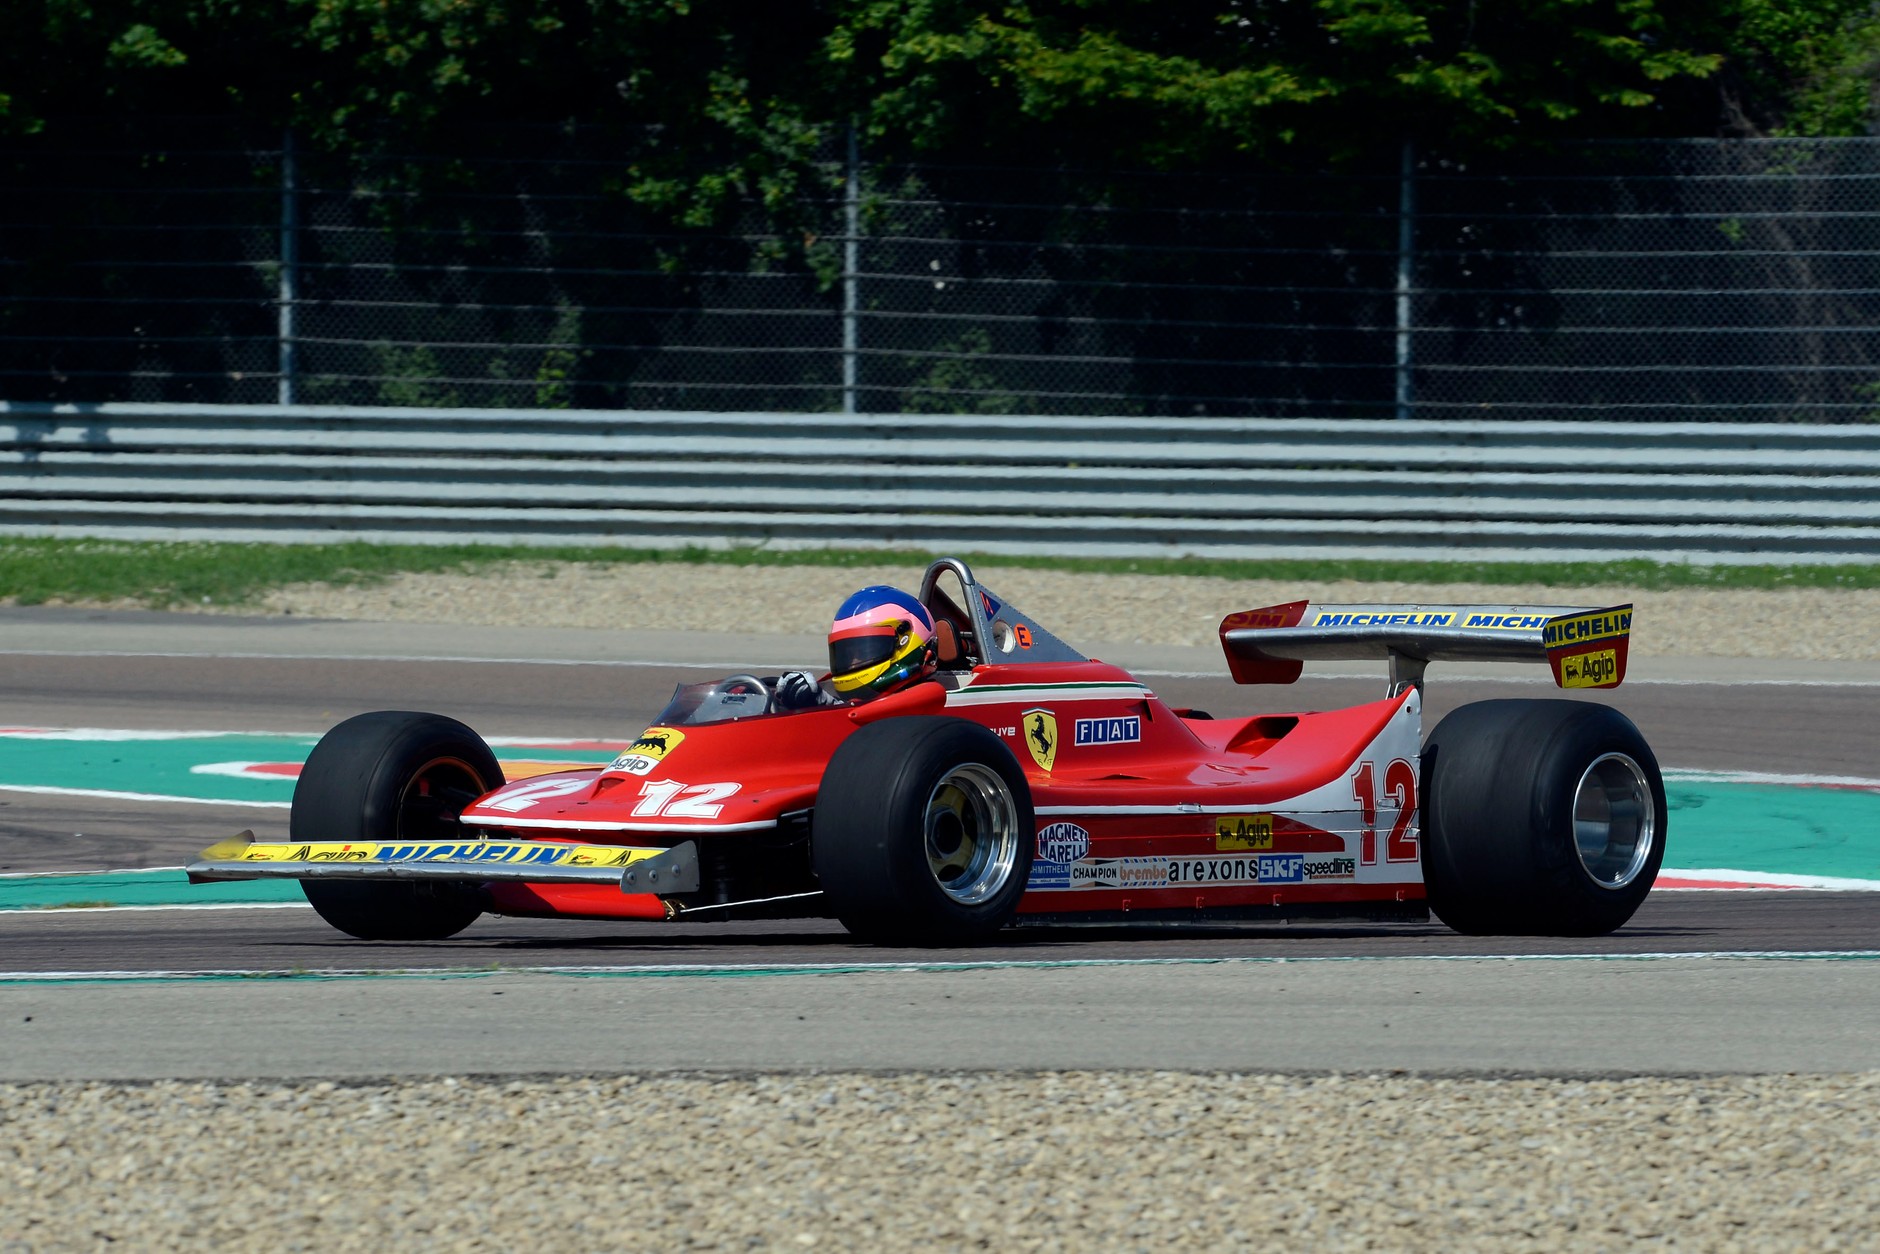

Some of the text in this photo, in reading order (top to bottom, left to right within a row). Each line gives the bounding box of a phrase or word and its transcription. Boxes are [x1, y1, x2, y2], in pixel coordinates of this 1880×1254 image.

[1317, 614, 1453, 627] MICHELIN
[1542, 612, 1632, 643] MICHELIN
[1581, 653, 1614, 682] Agip
[1080, 721, 1137, 741] FIAT
[630, 778, 742, 819] 12
[1351, 758, 1419, 866] 12
[1040, 824, 1088, 841] MAGNETI
[1236, 818, 1270, 847] Agip
[374, 845, 569, 863] MICHELIN
[1040, 841, 1088, 862] MARELLI
[1073, 868, 1117, 879] CHAMPION
[1120, 865, 1168, 880] brembo
[1168, 859, 1258, 881] arexons
[1259, 859, 1302, 879] SKF
[1303, 858, 1354, 880] speedline
